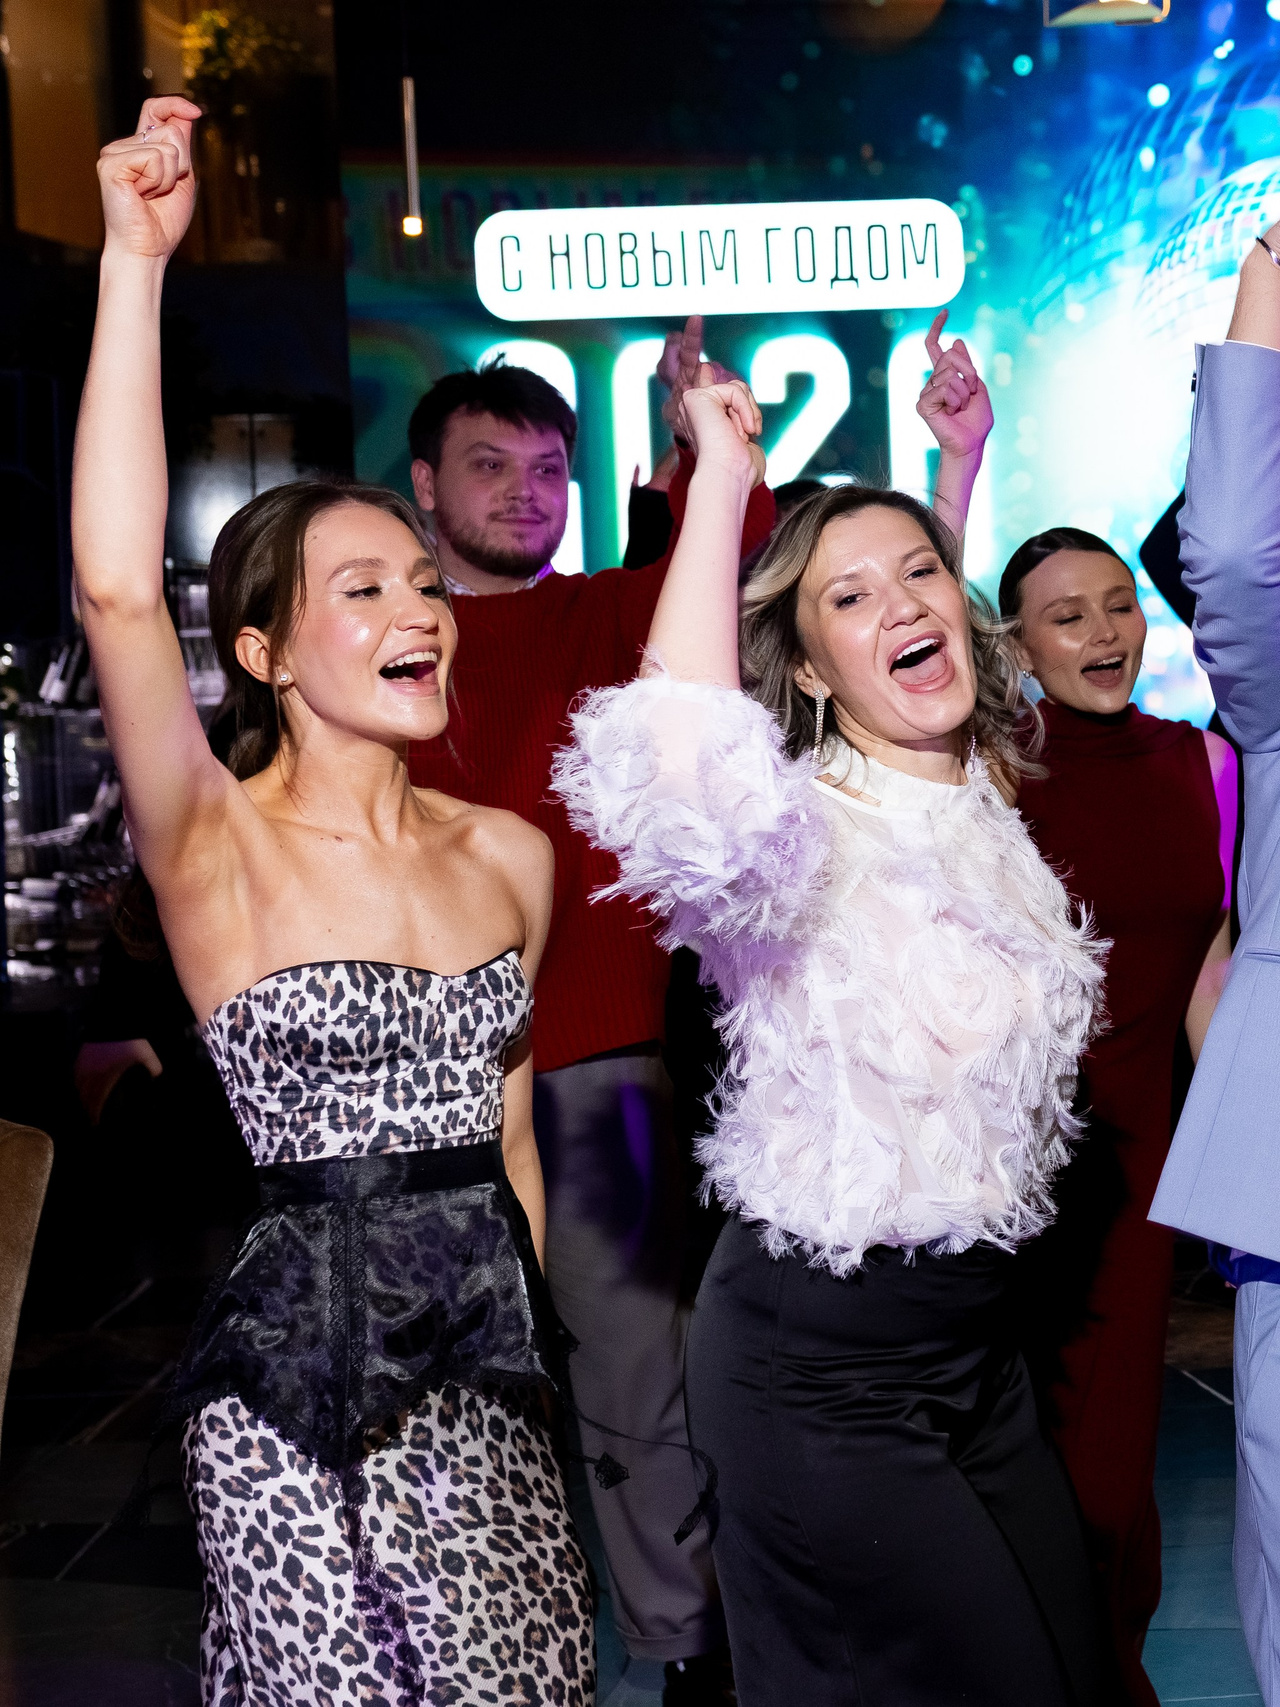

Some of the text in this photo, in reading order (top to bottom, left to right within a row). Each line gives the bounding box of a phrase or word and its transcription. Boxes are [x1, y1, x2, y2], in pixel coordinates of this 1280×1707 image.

[499, 234, 523, 292] С
[548, 228, 740, 291] НОВЫМ
[764, 222, 940, 289] ГОДОМ
